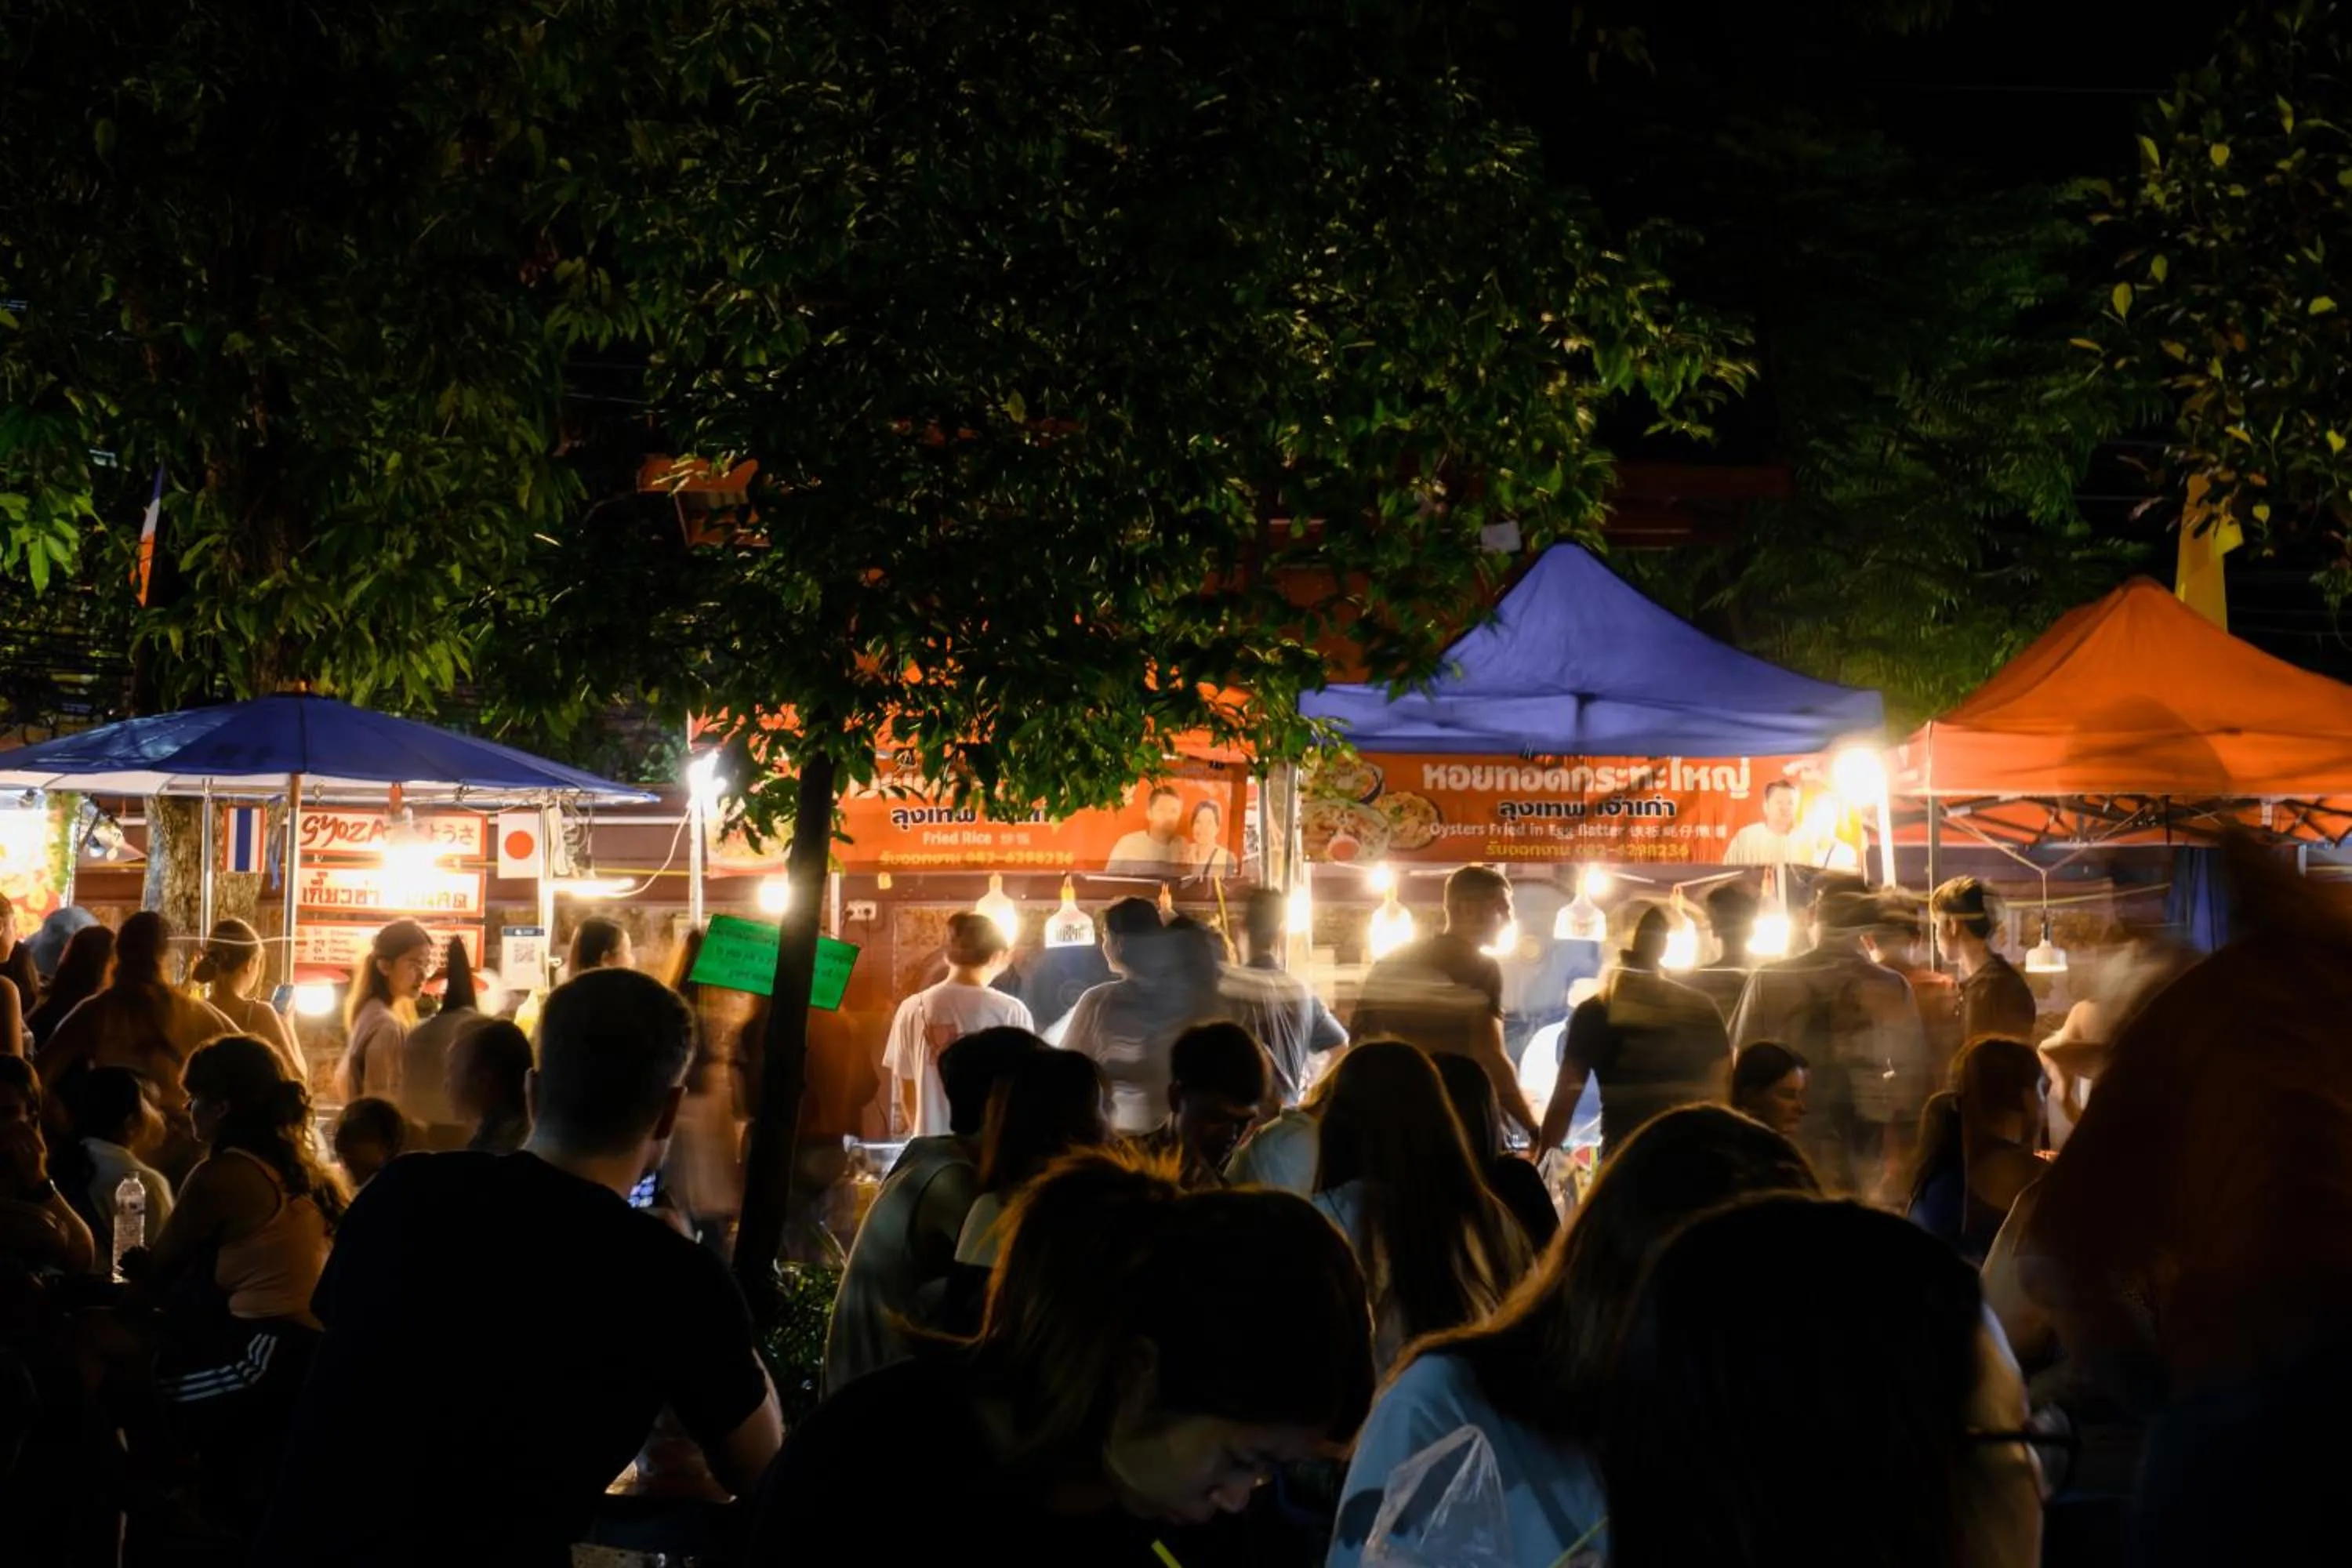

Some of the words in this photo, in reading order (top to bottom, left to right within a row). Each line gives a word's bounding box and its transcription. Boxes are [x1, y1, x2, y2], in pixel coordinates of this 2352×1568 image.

[923, 830, 959, 846] Fried
[962, 830, 993, 846] Rice
[1429, 823, 1485, 838] Oysters
[1489, 822, 1526, 837] Fried
[1530, 823, 1544, 836] in
